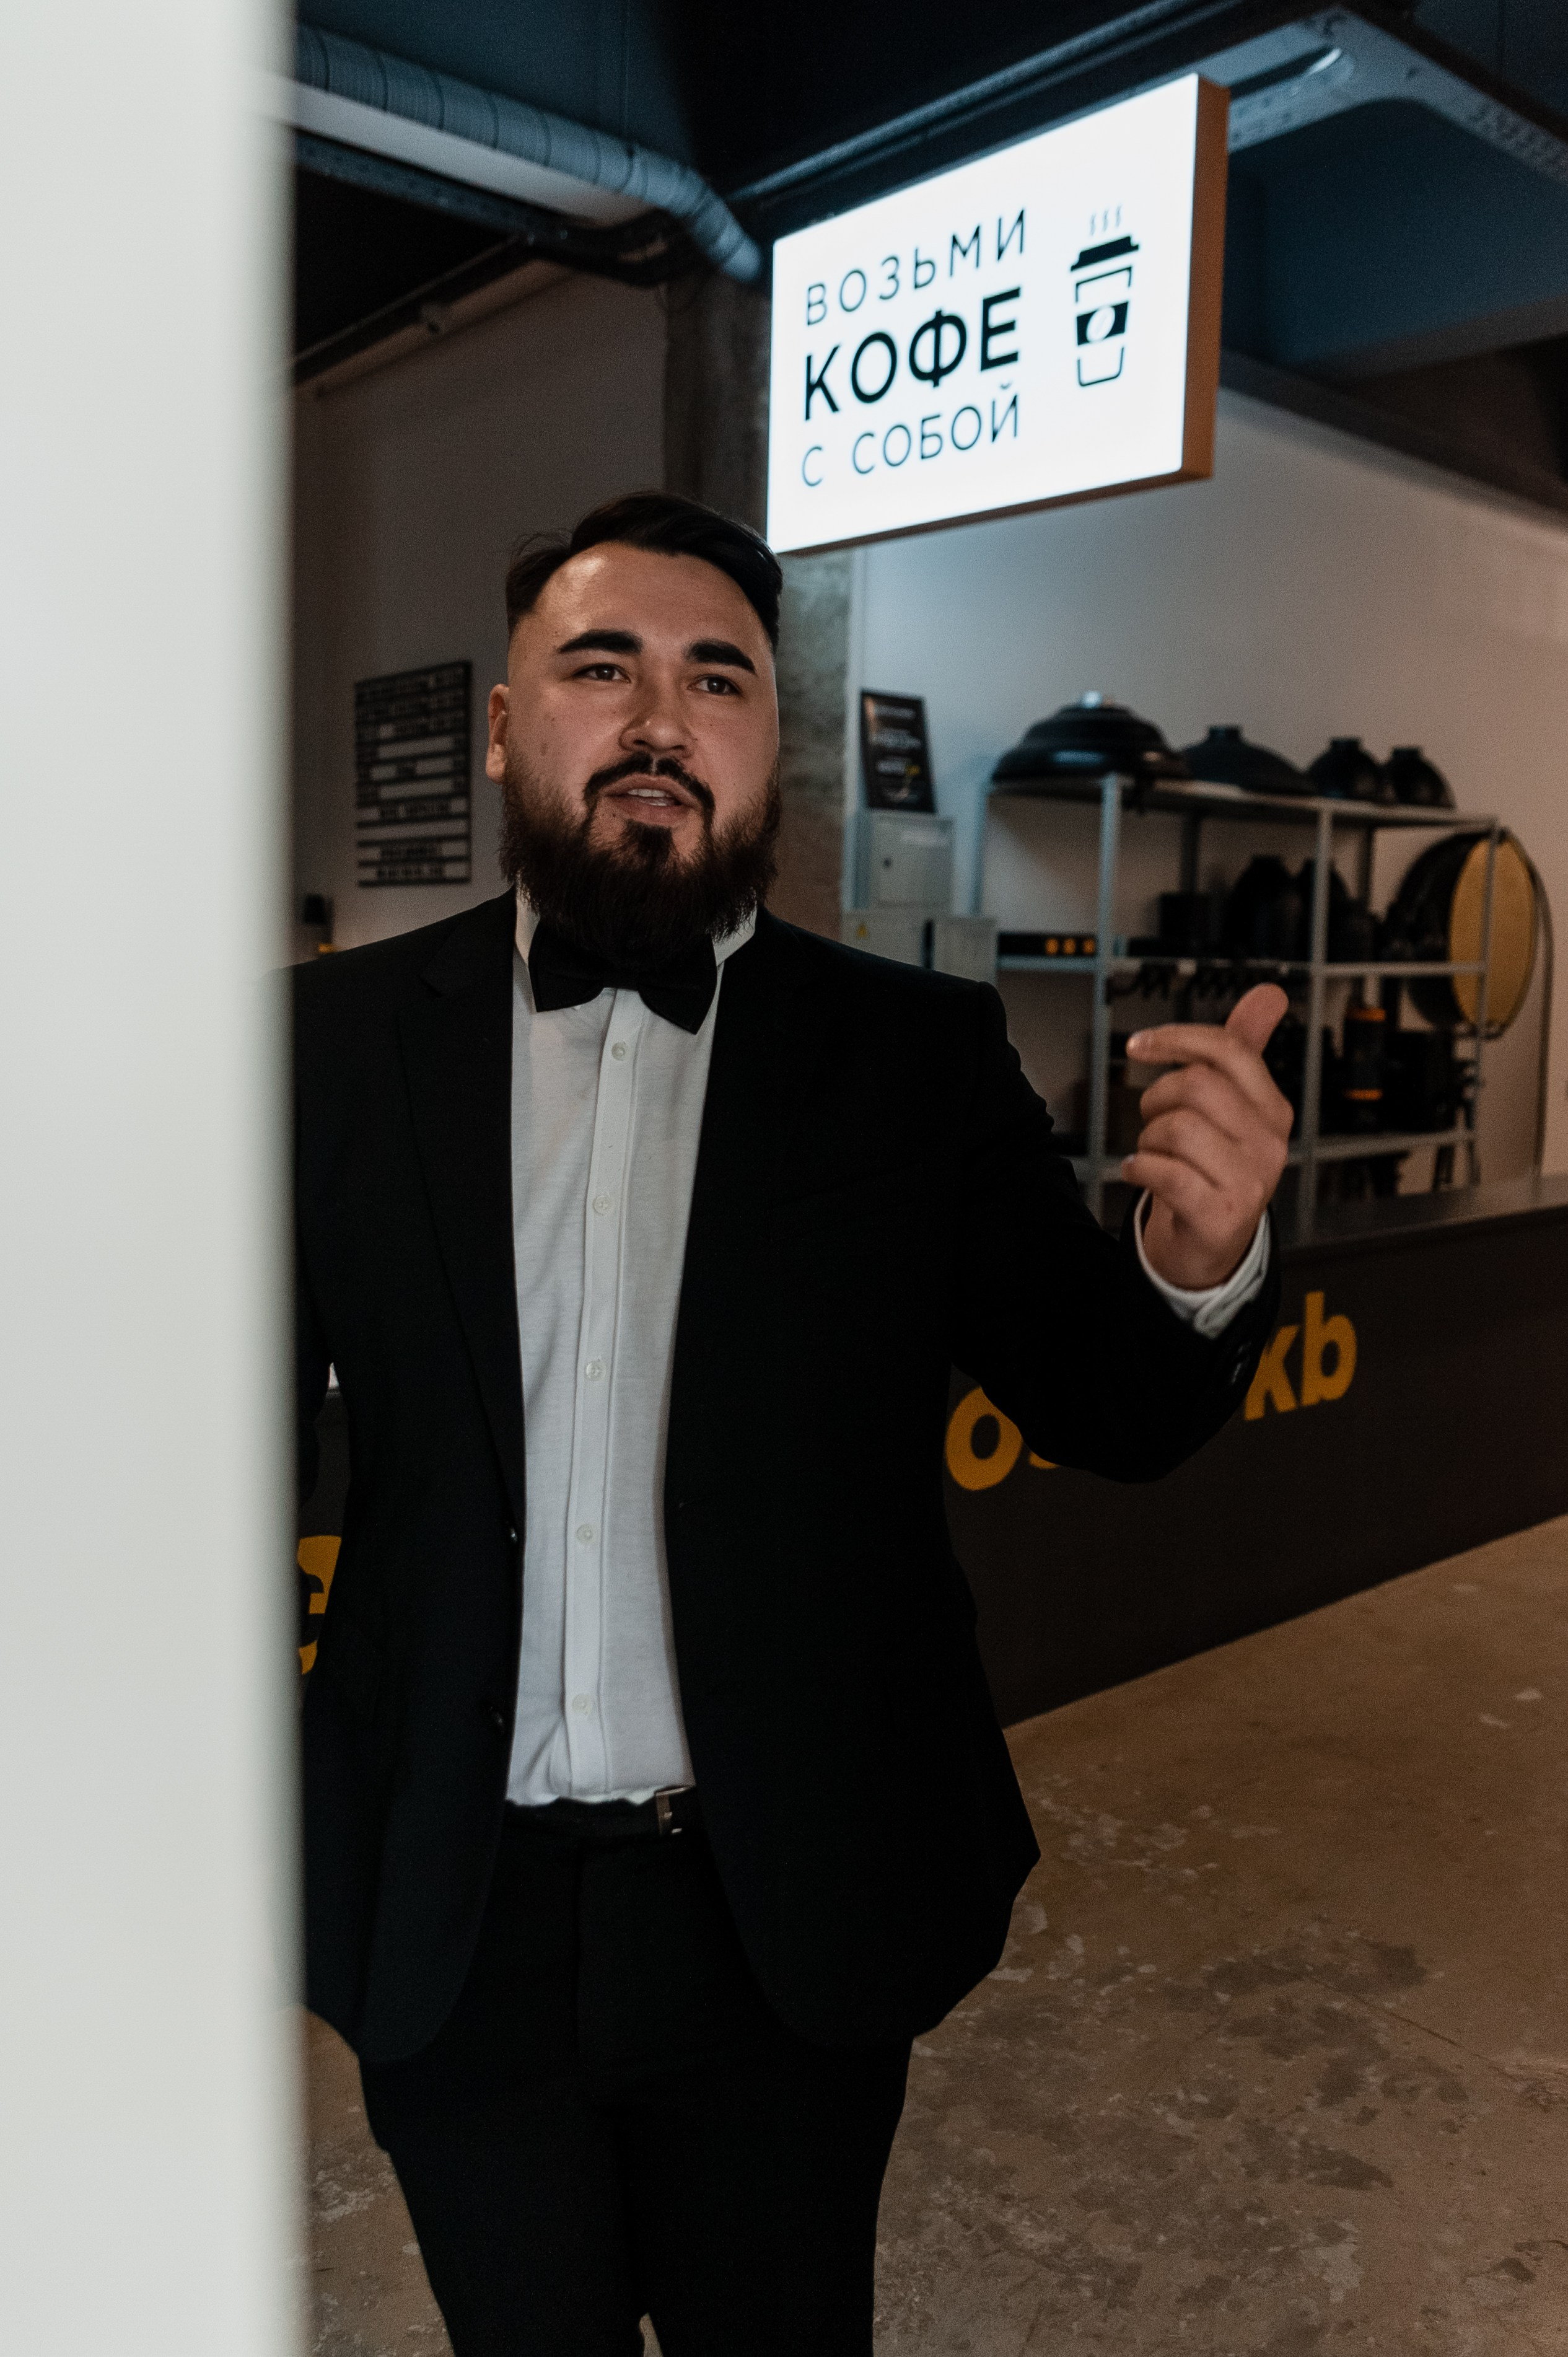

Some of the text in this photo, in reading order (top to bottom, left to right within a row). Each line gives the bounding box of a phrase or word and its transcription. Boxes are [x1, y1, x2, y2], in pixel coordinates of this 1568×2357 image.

[807, 208, 1026, 326] ВОЗЬМИ
[805, 286, 1022, 421] КОФЕ
[802, 380, 1019, 487] С СОБОЙ
